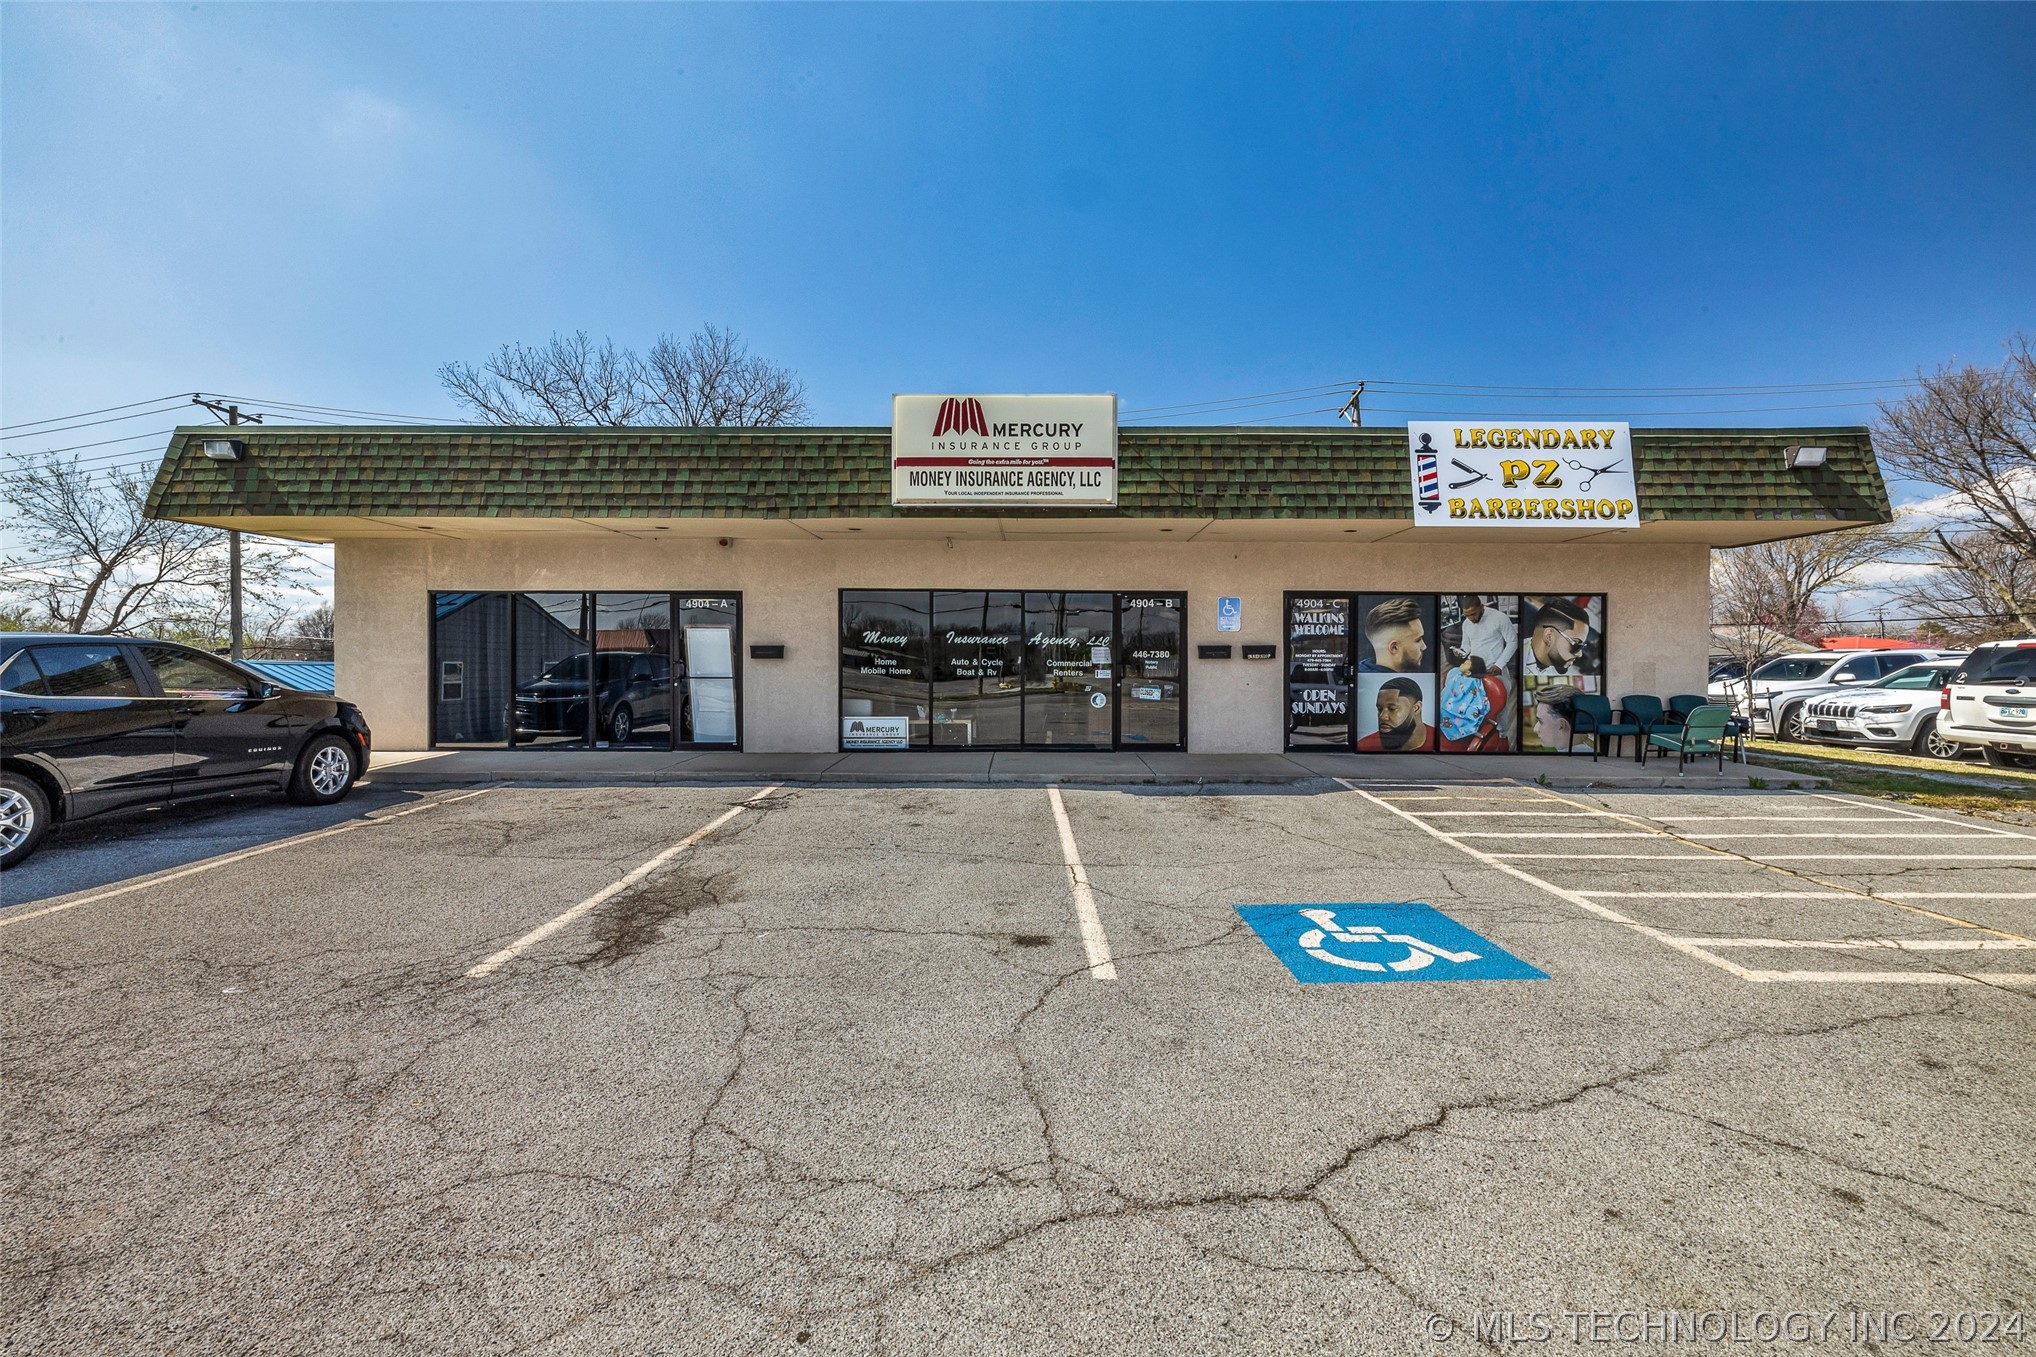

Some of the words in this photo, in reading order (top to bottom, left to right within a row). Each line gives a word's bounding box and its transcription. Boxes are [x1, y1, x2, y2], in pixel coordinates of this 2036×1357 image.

[992, 423, 1084, 437] MERCURY
[1453, 428, 1616, 450] LEGENDARY
[931, 442, 1020, 450] INSURANCE
[1031, 442, 1082, 450] GROUP
[1499, 459, 1562, 488] PZ
[910, 471, 952, 486] MONEY
[956, 471, 1023, 486] INSURANCE
[1027, 471, 1076, 489] AGENCY,
[1080, 472, 1102, 487] LLC
[1448, 498, 1634, 520] BARBERSHOP
[686, 599, 709, 608] 4904
[720, 599, 727, 607] A
[1130, 599, 1154, 607] 4904
[1166, 599, 1172, 607] B
[1296, 600, 1323, 608] 4904
[1333, 600, 1340, 608] C
[1294, 613, 1344, 623] WALKINS
[1294, 624, 1344, 635] WELCOME
[863, 631, 908, 647] Money
[946, 631, 1008, 644] Insurance
[1086, 636, 1110, 646] LLC
[981, 658, 1003, 667] Cycle
[1303, 690, 1336, 701] OPEN
[1292, 702, 1346, 714] SUNDAYS
